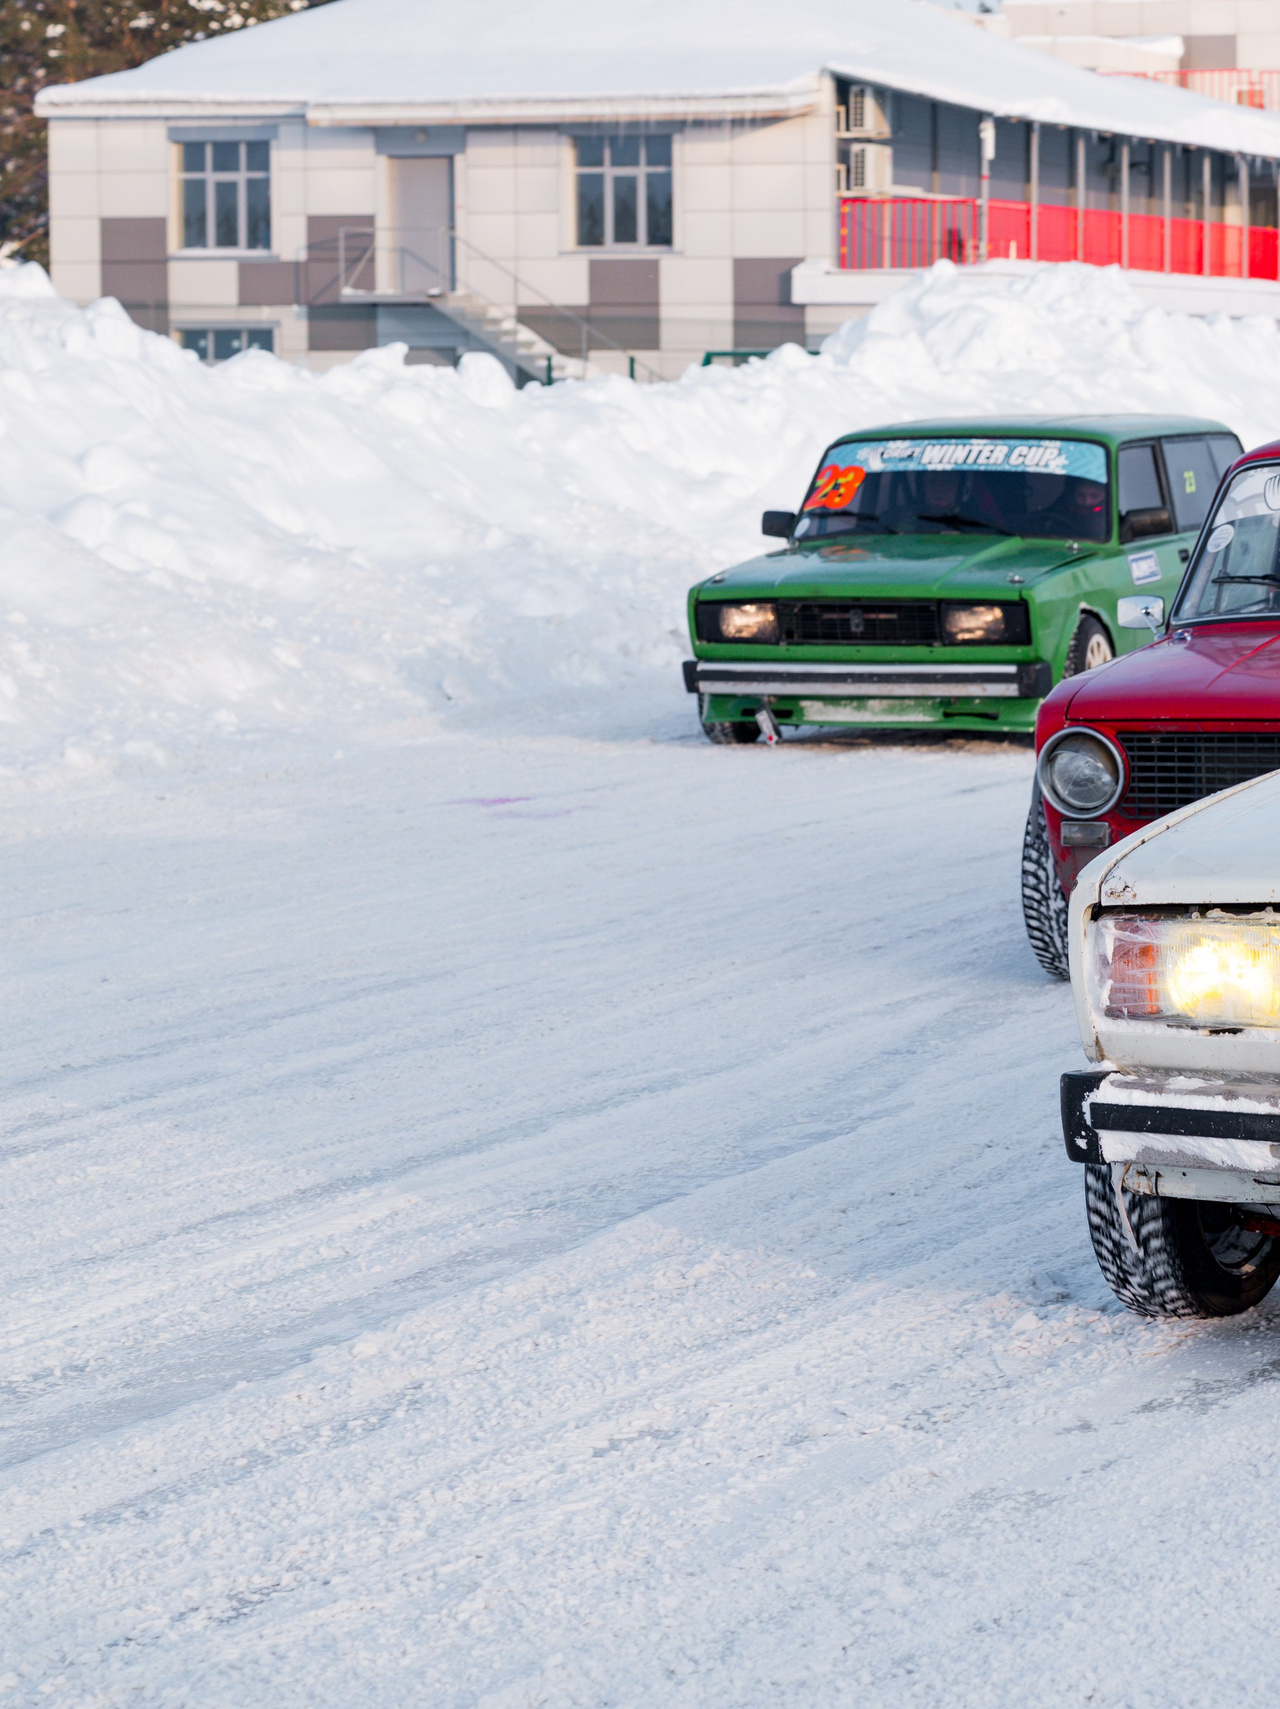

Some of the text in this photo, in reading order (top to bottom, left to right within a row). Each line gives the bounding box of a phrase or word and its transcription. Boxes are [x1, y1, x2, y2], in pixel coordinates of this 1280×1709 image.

[920, 444, 1008, 465] WINTER
[1009, 445, 1058, 467] CUP
[802, 464, 866, 511] 23
